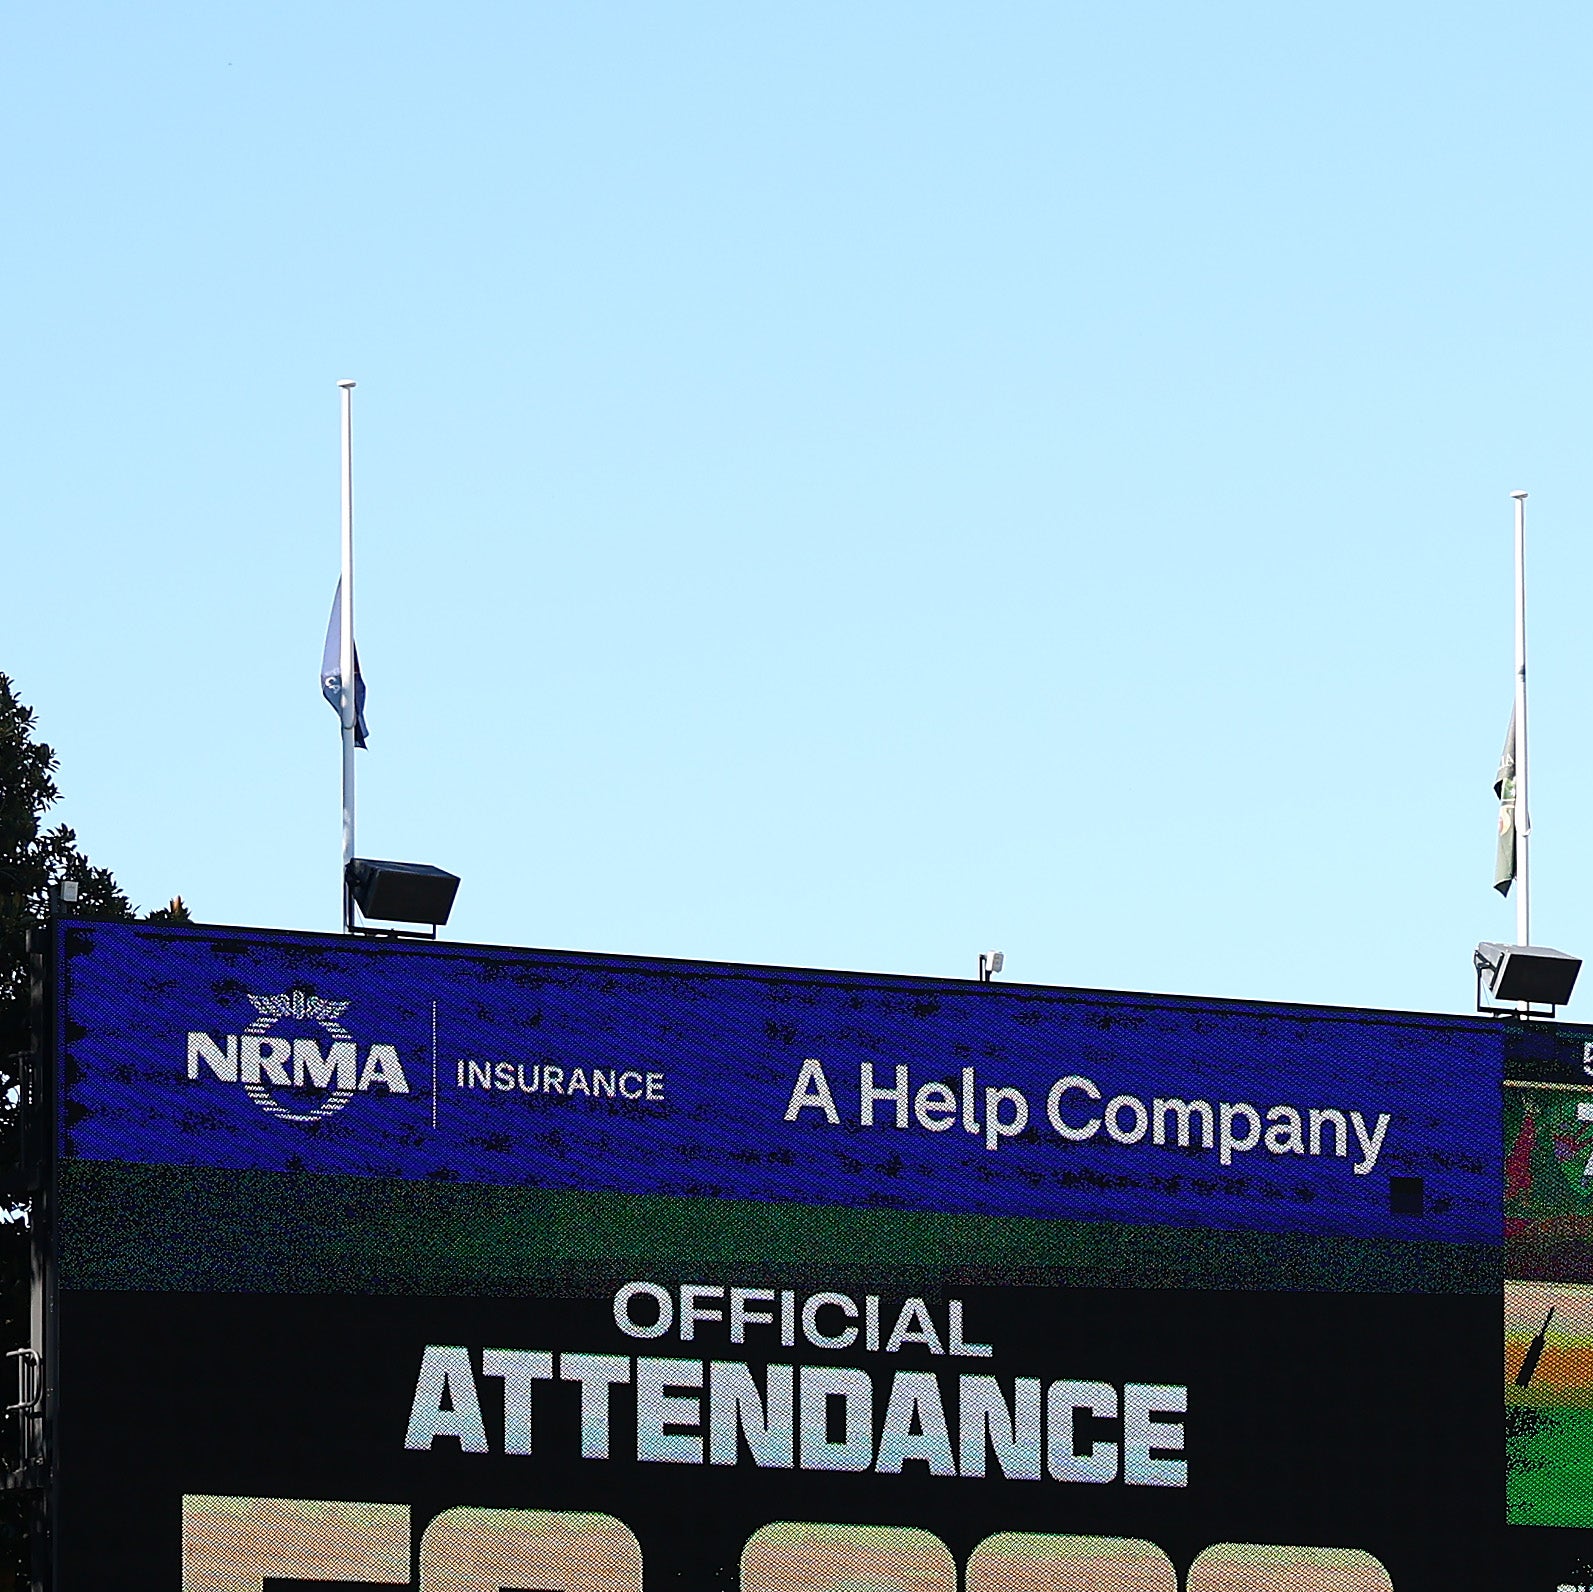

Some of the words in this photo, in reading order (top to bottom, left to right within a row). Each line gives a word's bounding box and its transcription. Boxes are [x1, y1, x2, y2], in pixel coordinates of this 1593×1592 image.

[187, 1031, 410, 1094] NRMA
[457, 1058, 664, 1102] INSURANCE
[784, 1058, 841, 1126] A
[859, 1062, 1030, 1150] Help
[1046, 1076, 1391, 1175] Company
[612, 1282, 993, 1358] OFFICIAL
[404, 1346, 1189, 1488] ATTENDANCE
